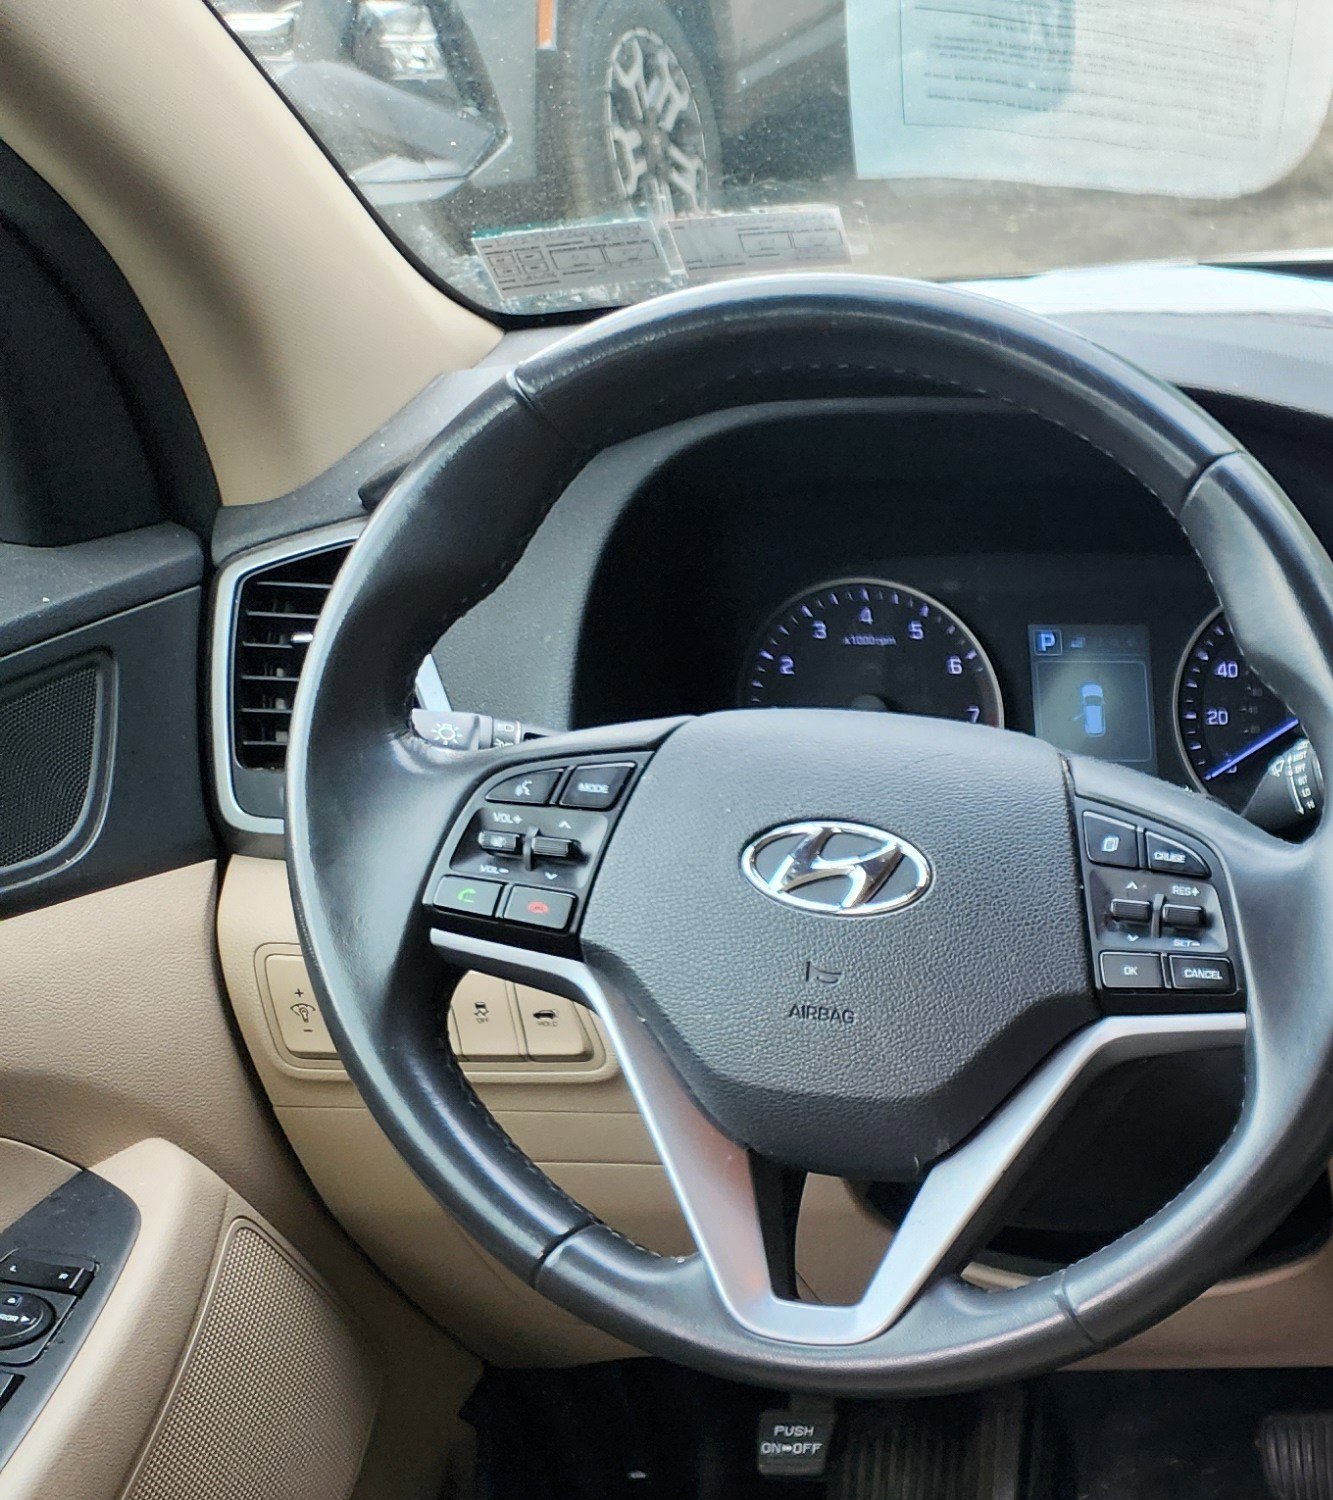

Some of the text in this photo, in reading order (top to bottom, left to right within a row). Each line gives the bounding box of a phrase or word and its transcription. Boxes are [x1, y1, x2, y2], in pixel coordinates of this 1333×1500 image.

[859, 605, 873, 625] 4
[811, 620, 827, 640] 3
[908, 620, 924, 640] 5
[1037, 631, 1056, 652] P
[779, 655, 795, 675] 2
[946, 655, 963, 675] 6
[1214, 660, 1239, 680] 40
[966, 705, 981, 724] 7
[1206, 707, 1229, 726] 20
[578, 781, 609, 795] MODE
[1123, 966, 1138, 976] OK
[1184, 968, 1223, 980] CANCEL
[788, 1003, 855, 1024] AIRBAG
[773, 1425, 815, 1437] PUSH
